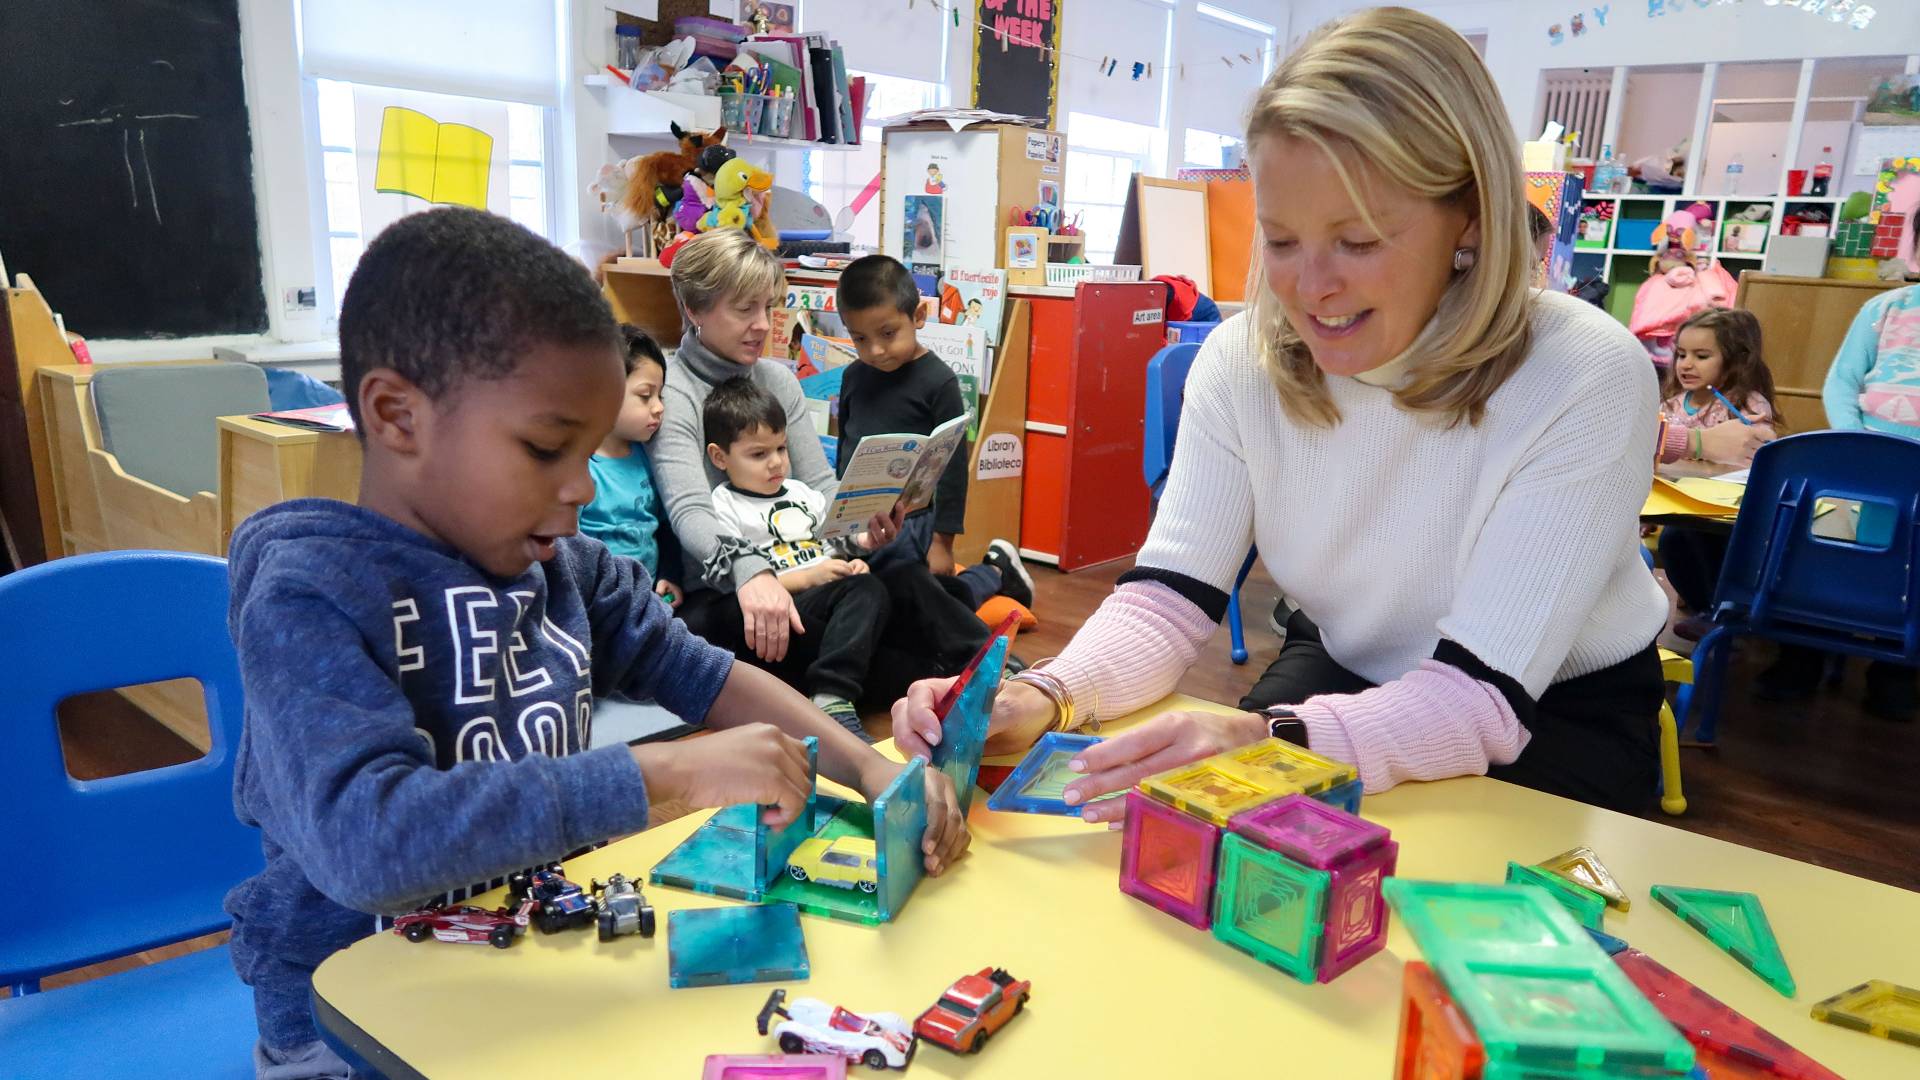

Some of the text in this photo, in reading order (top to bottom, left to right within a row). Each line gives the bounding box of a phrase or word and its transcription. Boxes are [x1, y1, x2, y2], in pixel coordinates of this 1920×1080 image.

[1016, 0, 1051, 20] THE
[994, 14, 1043, 48] WEEK
[787, 293, 796, 308] 2
[801, 294, 810, 309] 3
[824, 296, 834, 311] 4
[1135, 312, 1145, 322] Art
[988, 440, 1016, 453] Library
[980, 459, 1021, 470] Biblioteca
